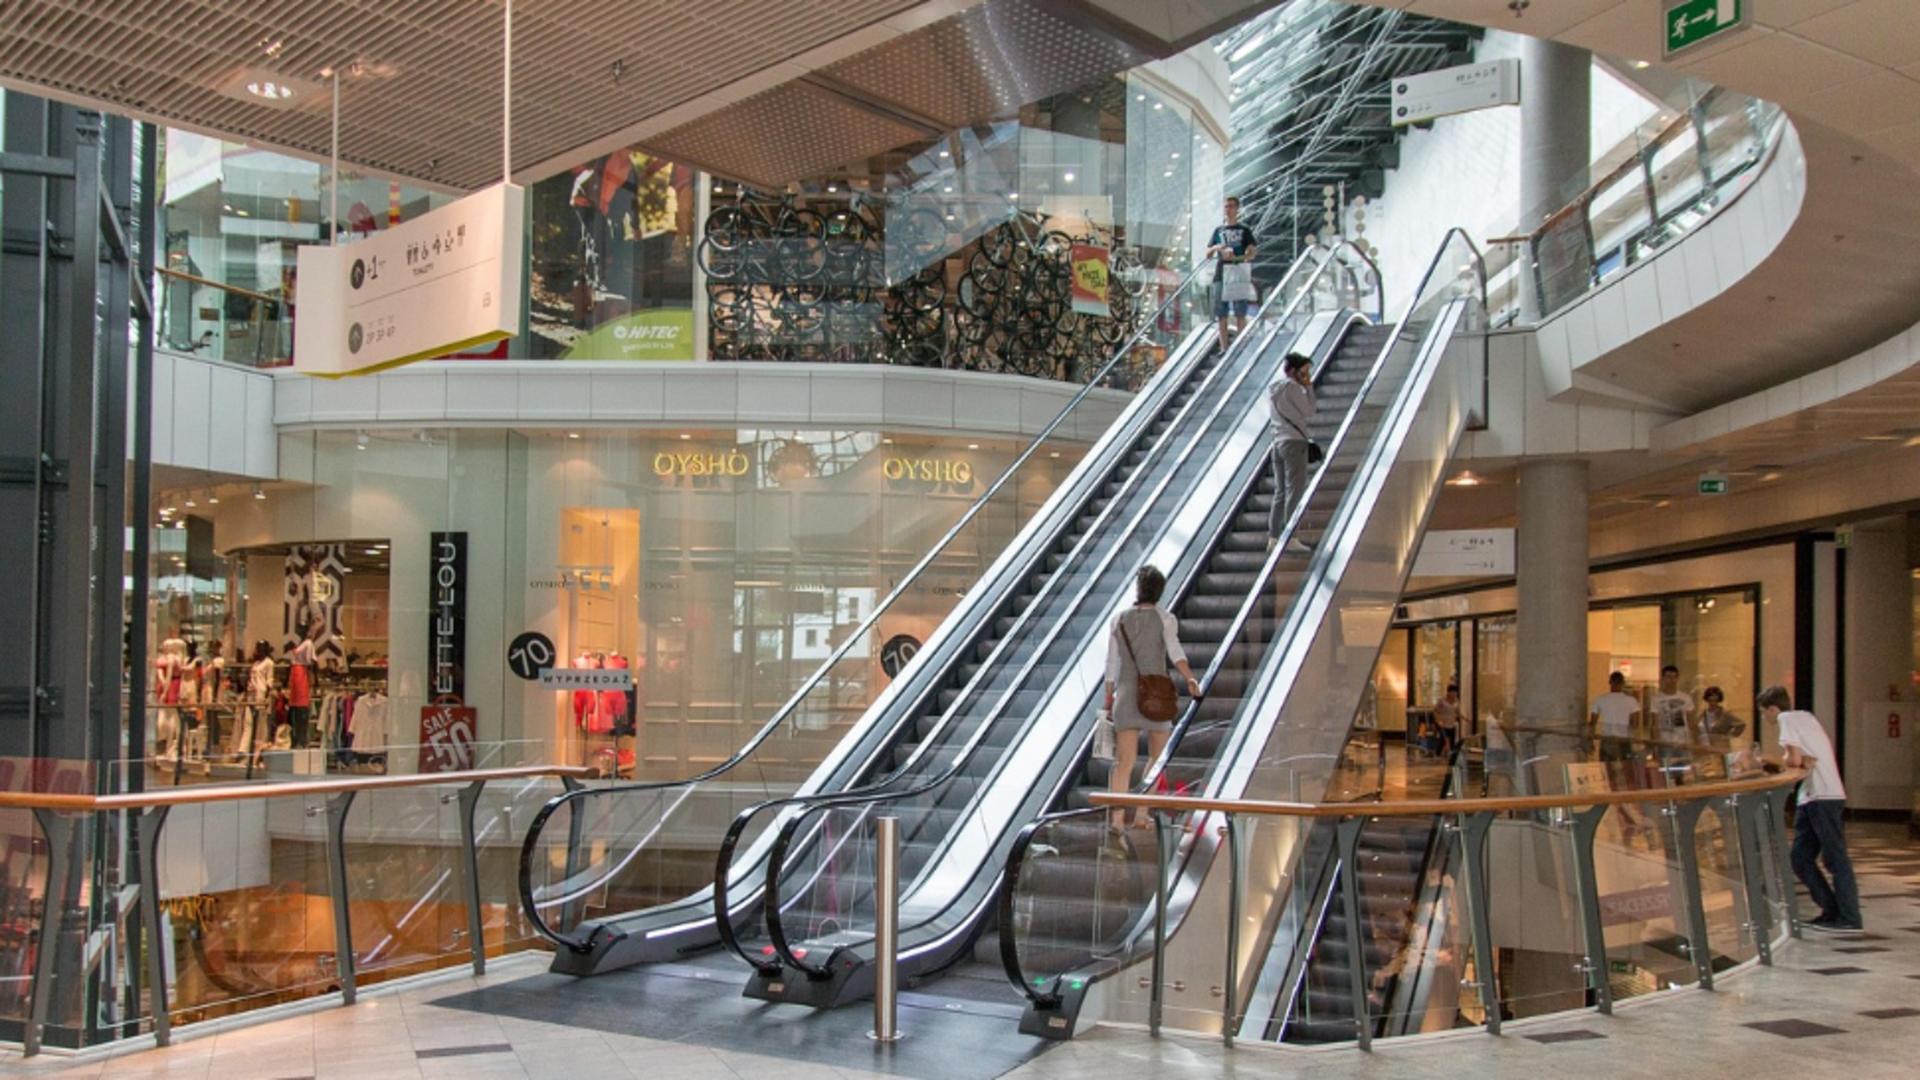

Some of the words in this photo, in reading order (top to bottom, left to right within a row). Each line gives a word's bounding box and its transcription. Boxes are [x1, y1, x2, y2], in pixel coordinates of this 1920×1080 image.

[629, 326, 679, 339] HI-TEC
[654, 452, 749, 475] OYSHO
[883, 458, 970, 483] OYSHO
[510, 639, 549, 676] 70
[423, 708, 453, 734] SALE
